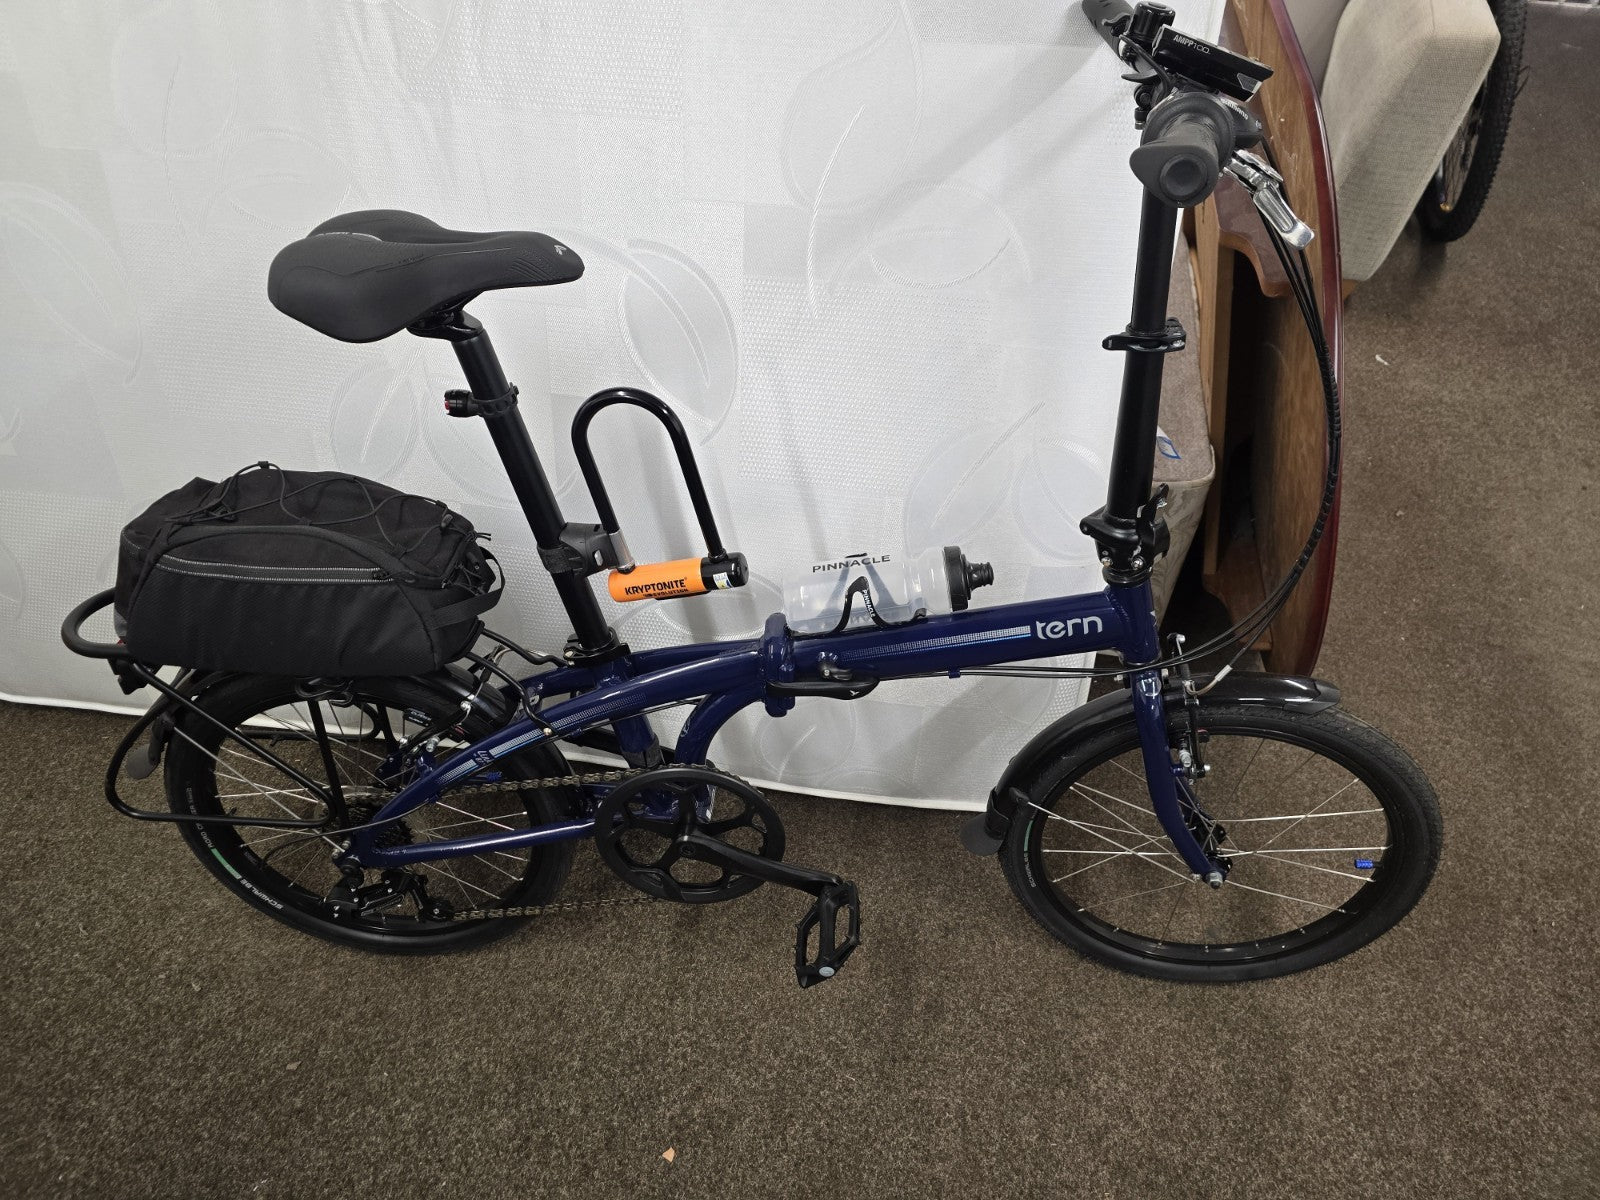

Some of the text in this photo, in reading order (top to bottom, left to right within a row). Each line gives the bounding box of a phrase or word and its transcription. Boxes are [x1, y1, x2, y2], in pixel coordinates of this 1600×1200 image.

[812, 554, 891, 573] PINNACLE
[624, 578, 686, 596] KRYPTONITE
[862, 589, 876, 618] PINNACLE
[1035, 616, 1103, 640] tern
[241, 878, 284, 910] SCHWALBE
